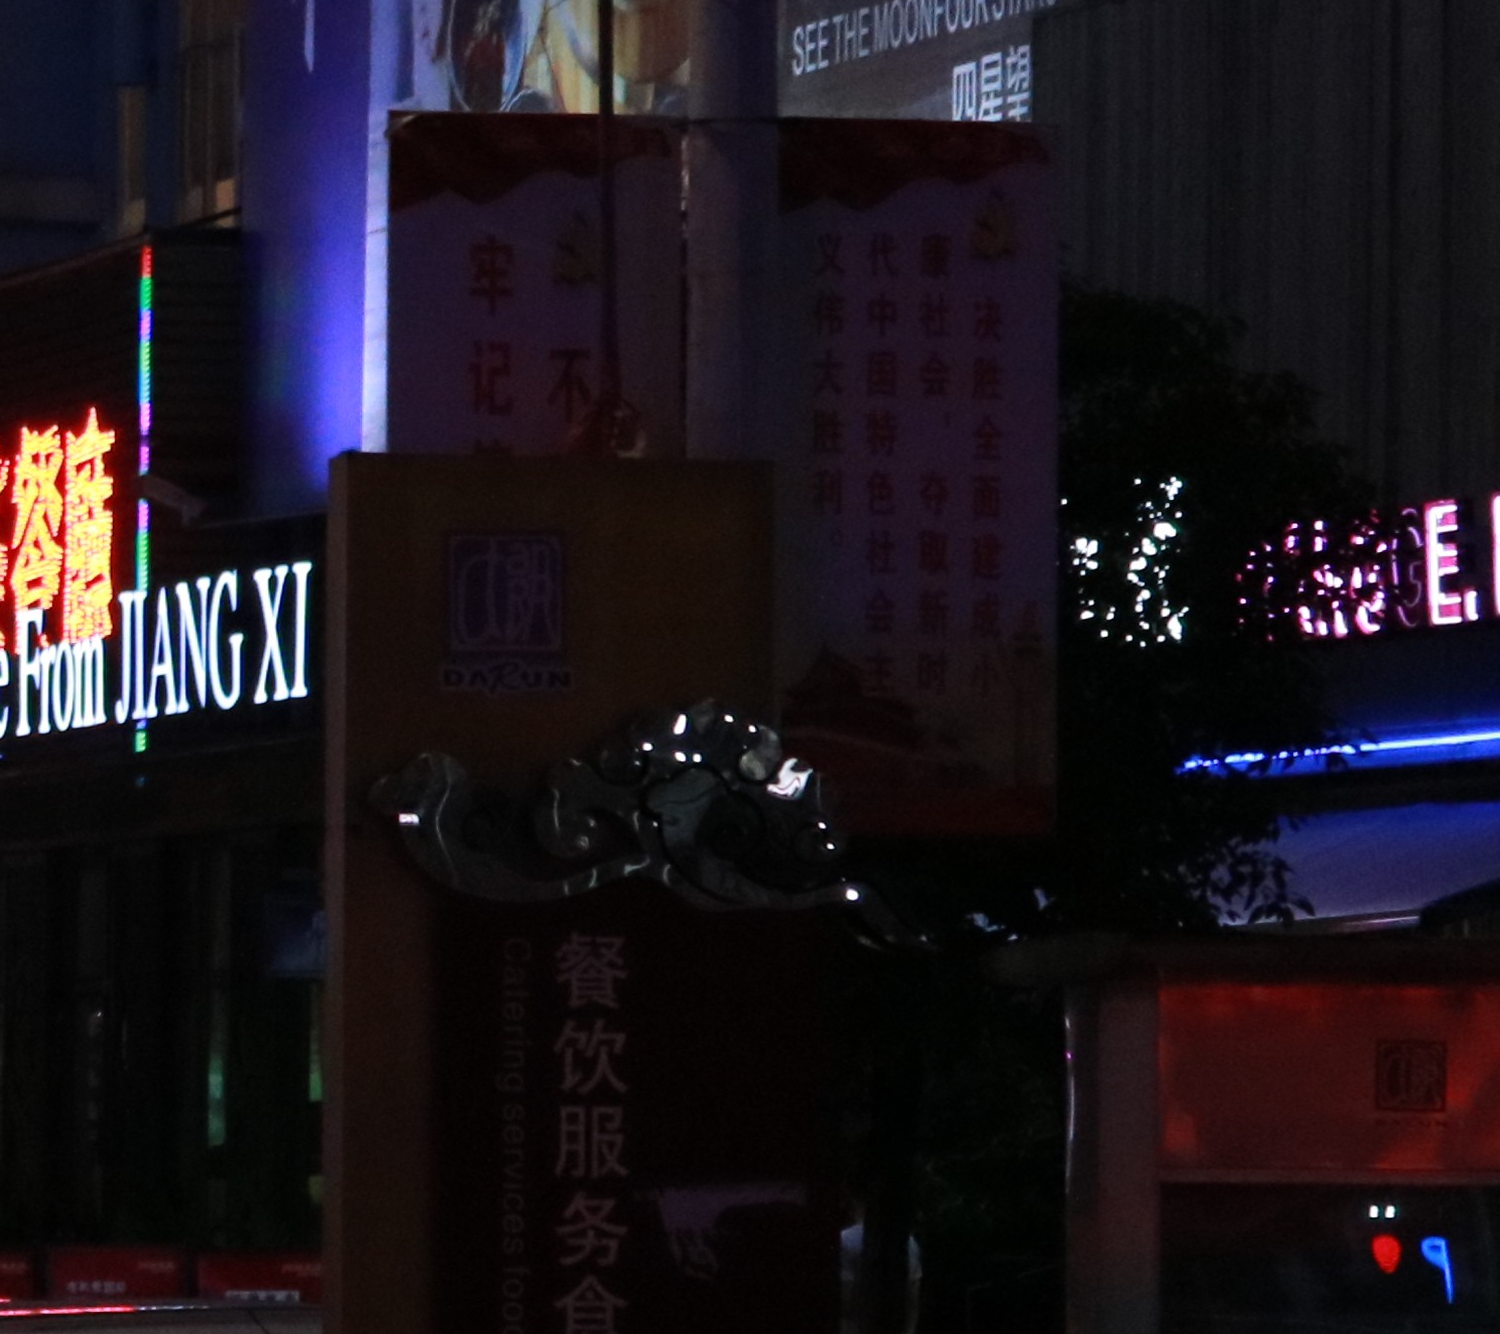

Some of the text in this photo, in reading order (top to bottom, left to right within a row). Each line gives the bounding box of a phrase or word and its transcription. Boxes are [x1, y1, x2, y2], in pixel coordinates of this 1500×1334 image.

[791, 18, 830, 76] SEE
[832, 6, 871, 65] THE
[15, 605, 104, 737] From
[501, 1103, 524, 1257] services
